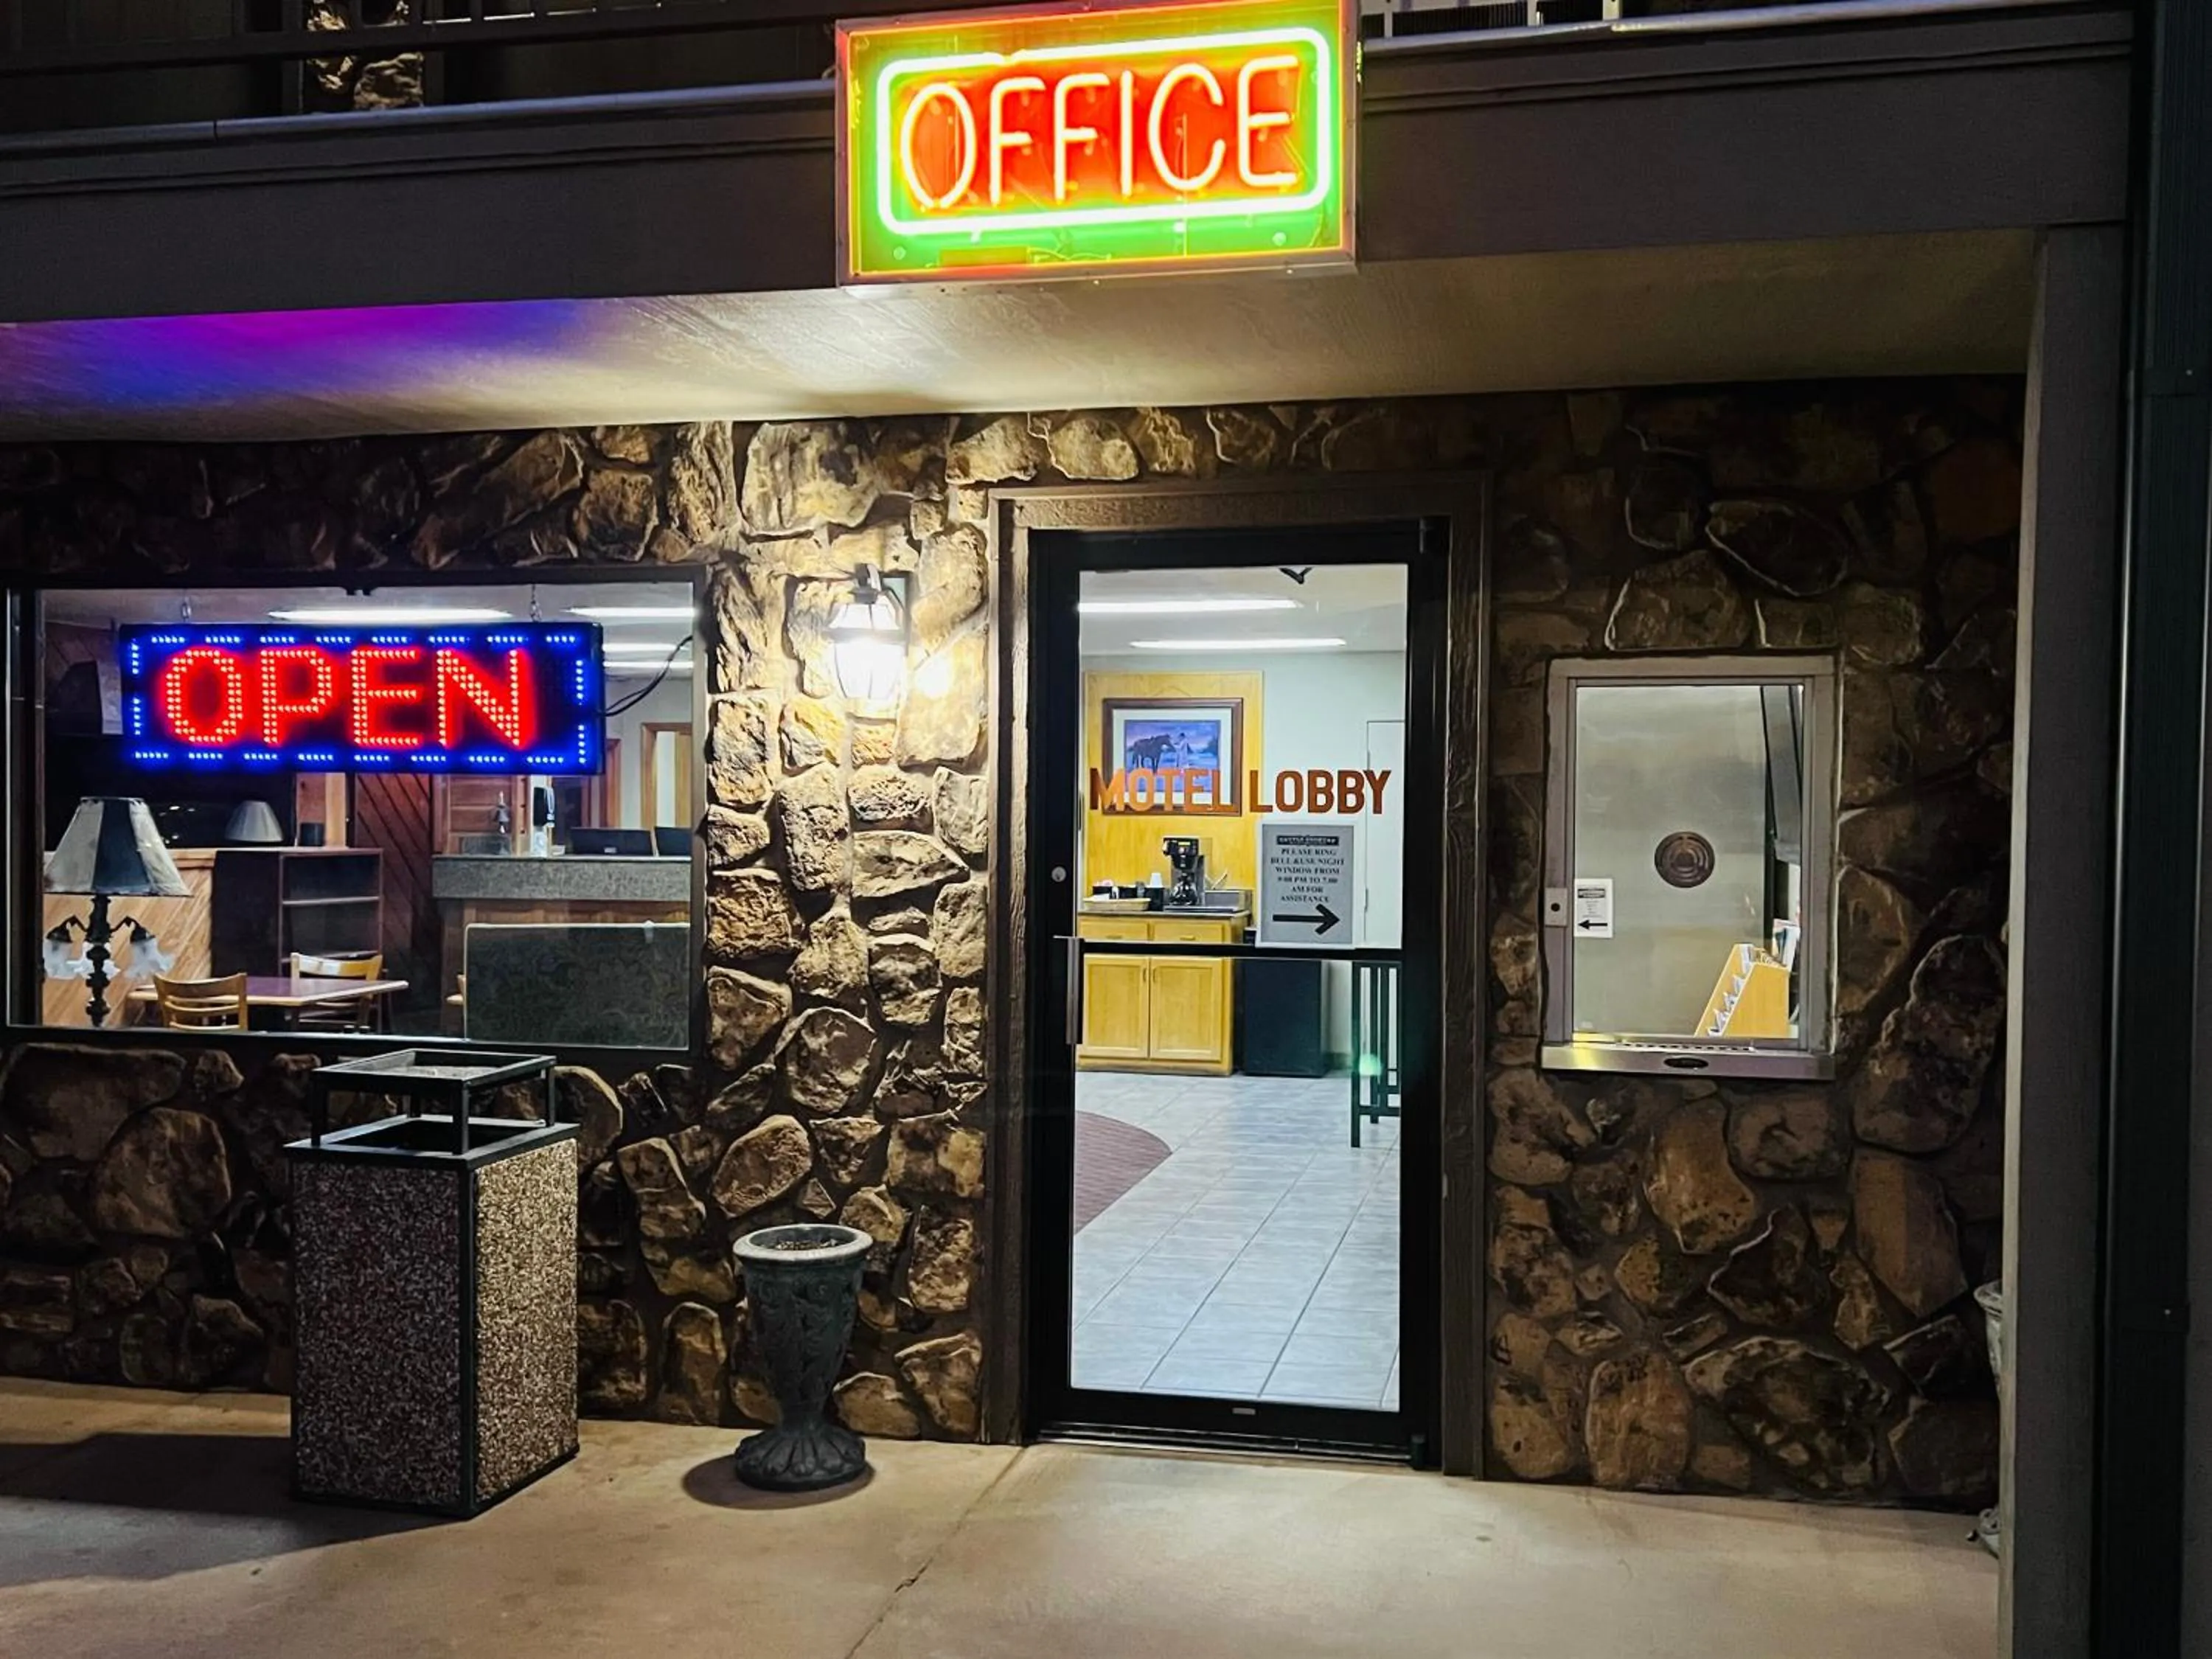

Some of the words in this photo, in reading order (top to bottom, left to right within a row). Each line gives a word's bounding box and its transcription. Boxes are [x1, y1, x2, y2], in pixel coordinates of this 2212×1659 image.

[901, 56, 1297, 209] OFFICE
[164, 647, 522, 745] OPEN
[1090, 768, 1235, 812] MOTEL
[1249, 770, 1391, 814] LOBBY
